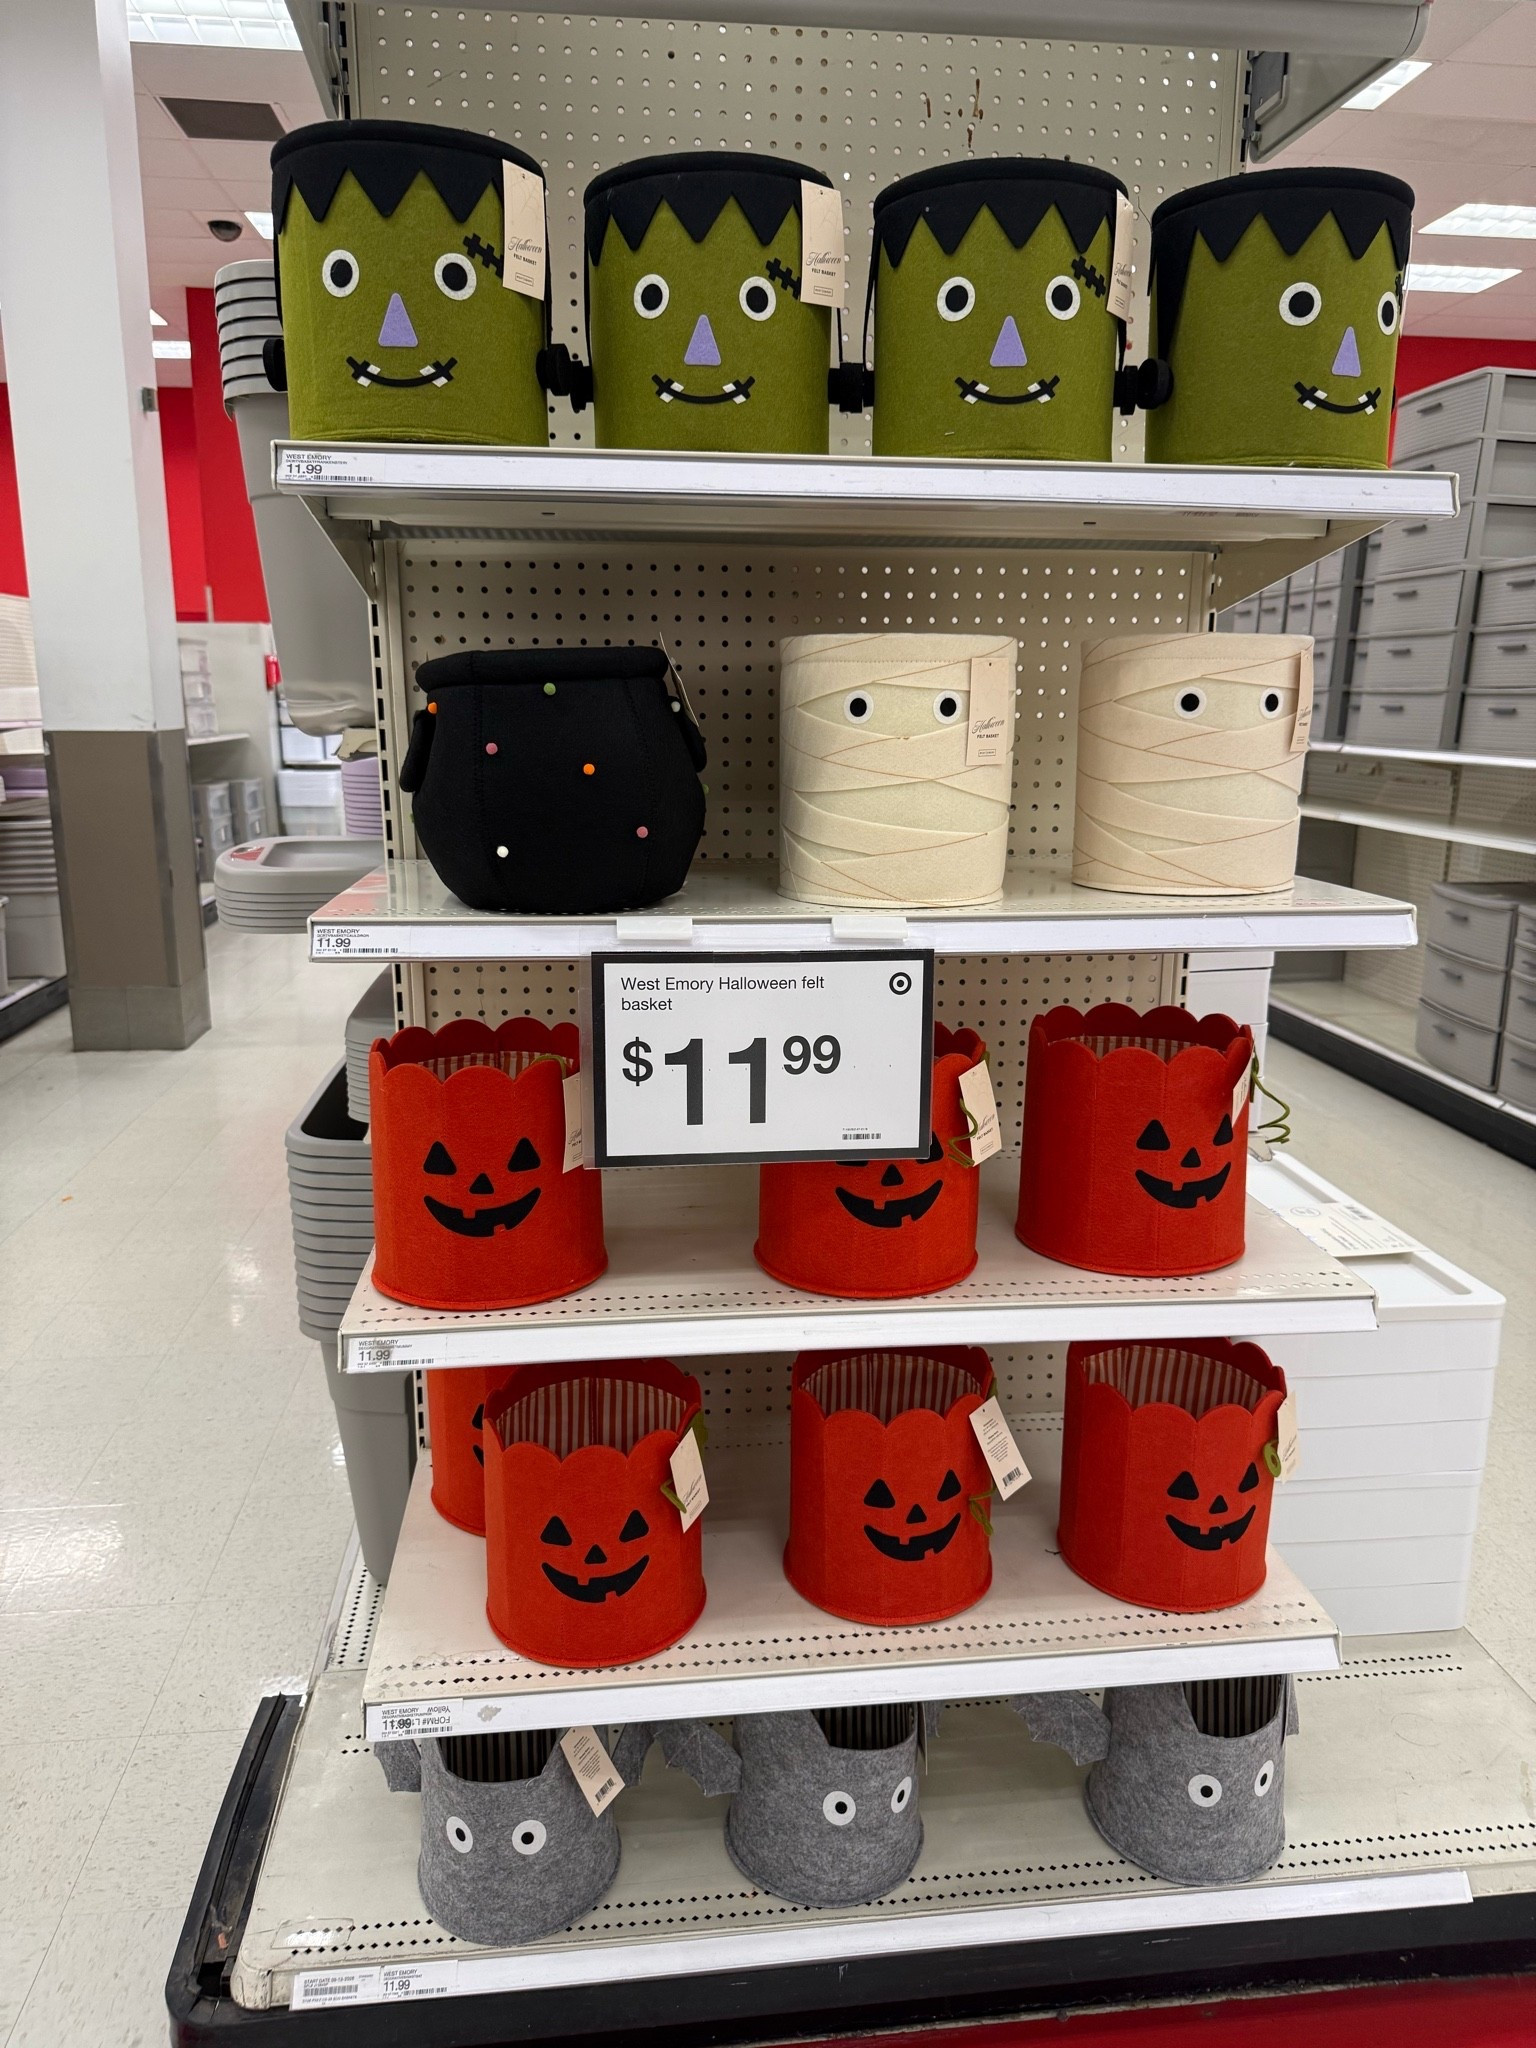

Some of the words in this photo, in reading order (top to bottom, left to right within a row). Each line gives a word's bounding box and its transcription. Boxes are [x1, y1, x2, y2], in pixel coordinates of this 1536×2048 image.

[507, 236, 543, 254] Halloween
[805, 251, 842, 266] Halloween
[286, 463, 323, 475] 11.99
[971, 716, 1005, 734] Halloween
[317, 937, 351, 948] 11.99
[620, 976, 660, 991] West
[664, 976, 715, 994] Emory
[718, 975, 797, 990] Halloween
[801, 975, 825, 989] felt
[621, 997, 673, 1012] basket
[358, 1350, 391, 1362] 11.99
[427, 1705, 451, 1714] Yellow
[382, 1718, 412, 1731] 11.99
[422, 1716, 451, 1726] FORM#
[383, 1979, 411, 1992] 11.99
